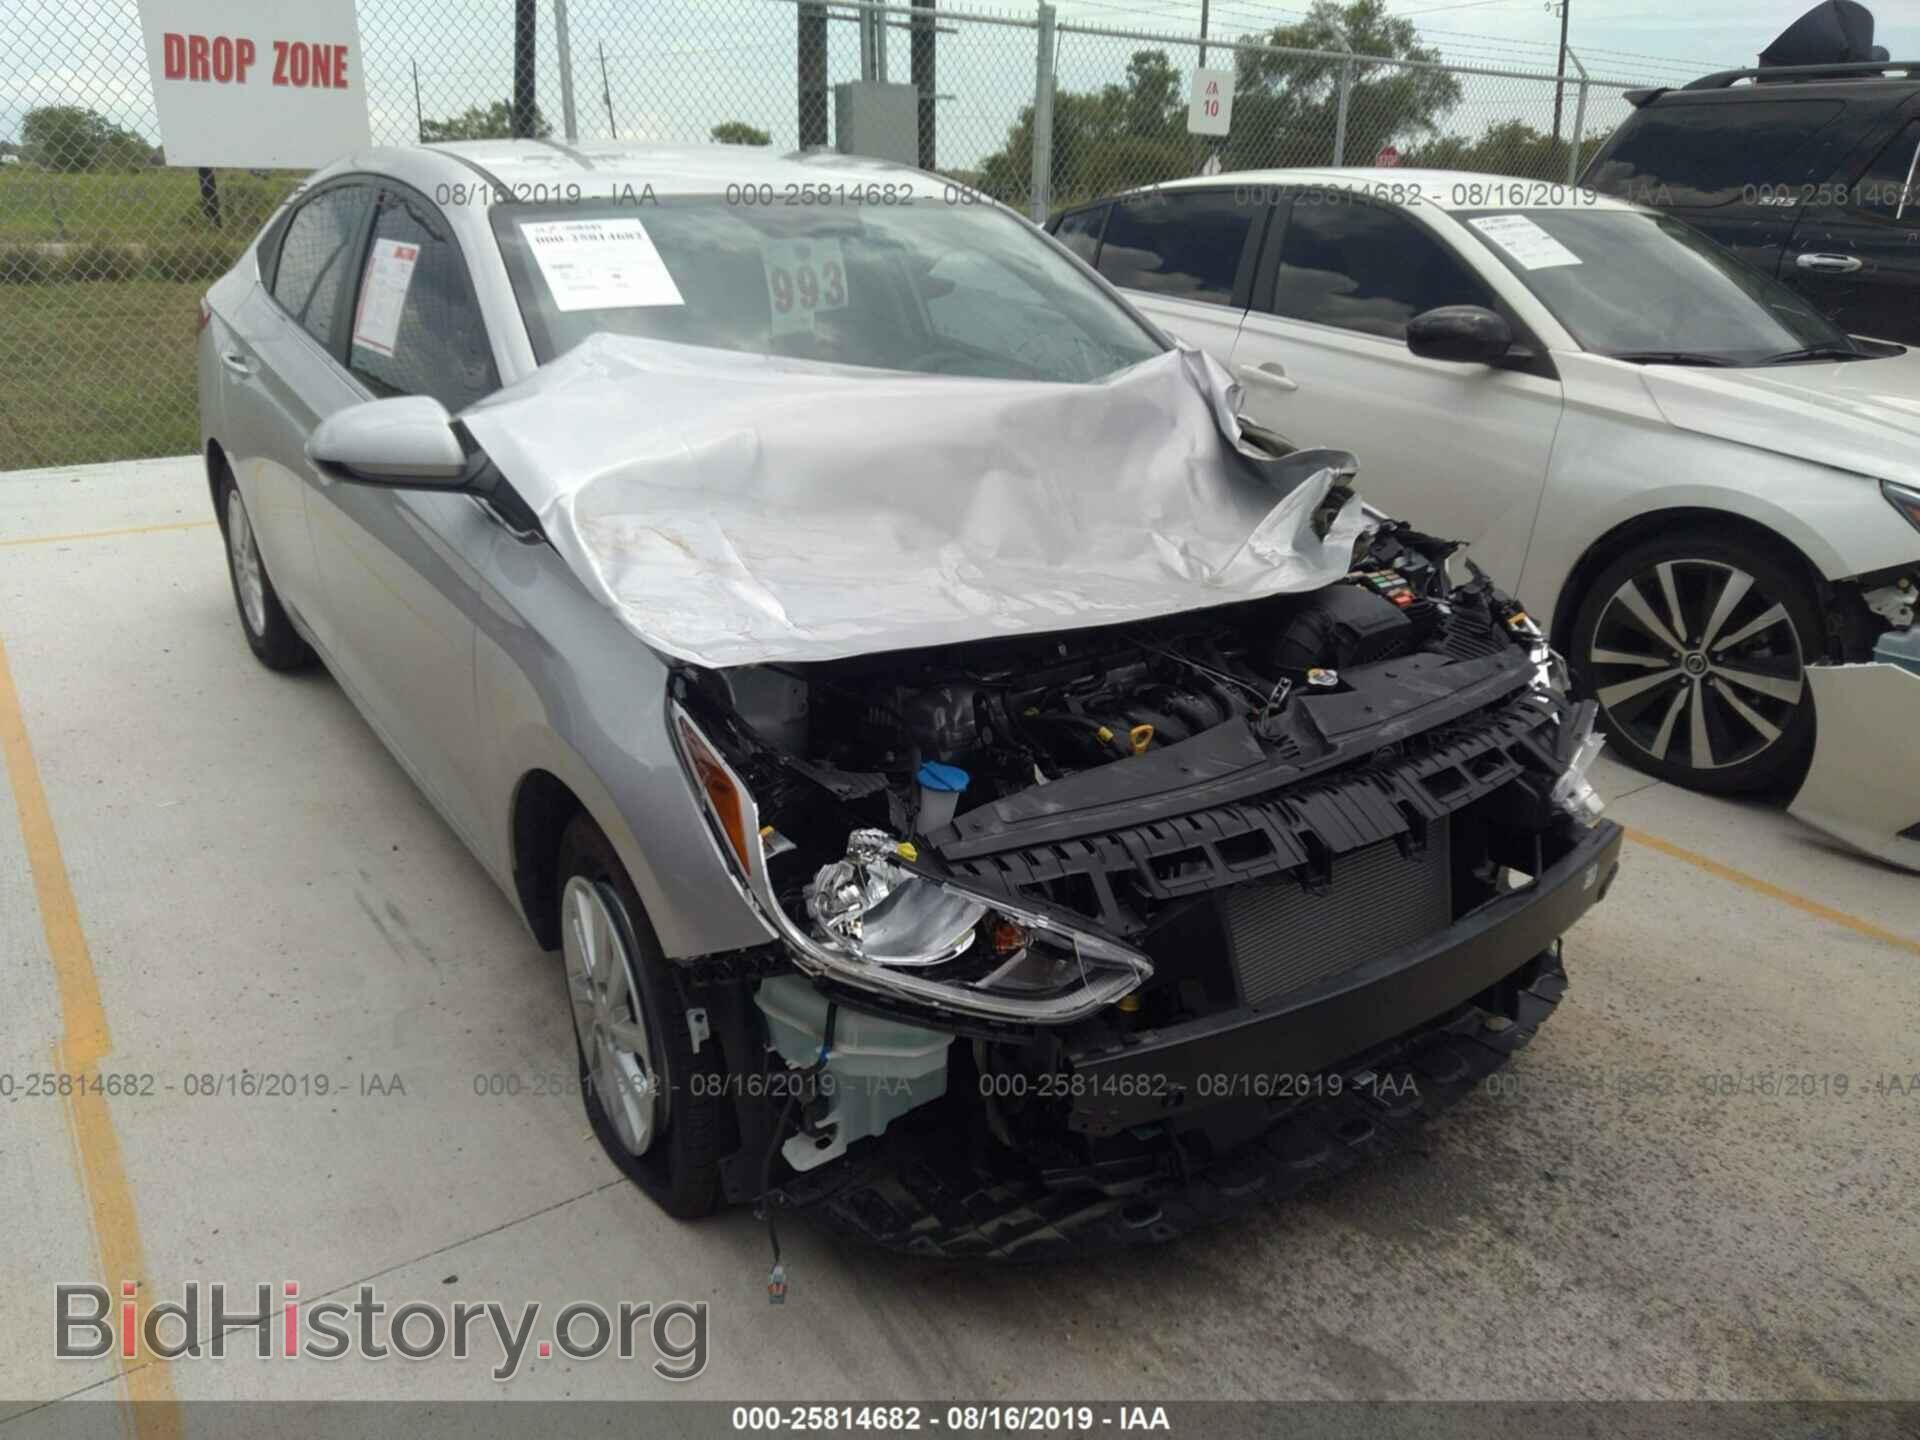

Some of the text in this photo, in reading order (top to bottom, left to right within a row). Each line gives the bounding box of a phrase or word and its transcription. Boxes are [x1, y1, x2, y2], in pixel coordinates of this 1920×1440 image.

[164, 32, 349, 89] DROP ZONE
[1204, 99, 1219, 117] 10
[770, 259, 846, 314] 993
